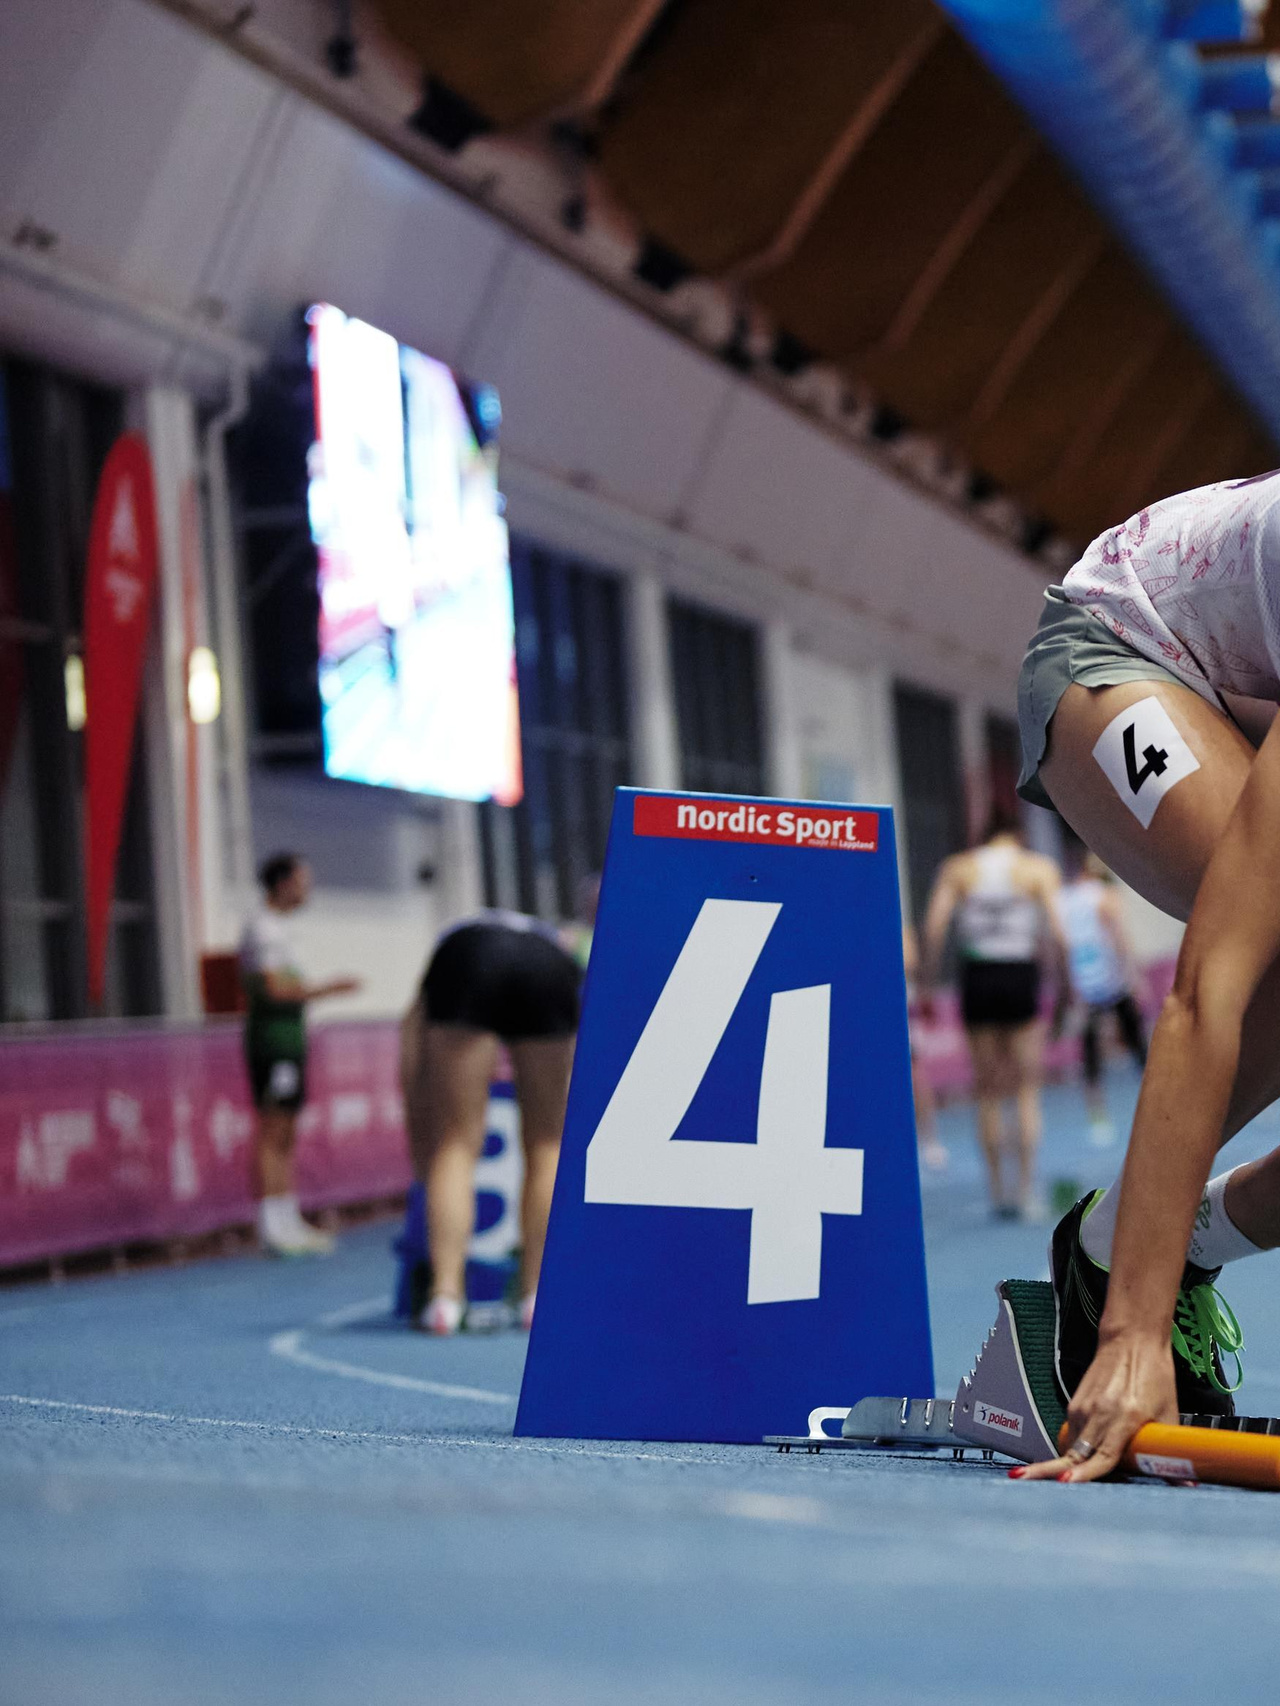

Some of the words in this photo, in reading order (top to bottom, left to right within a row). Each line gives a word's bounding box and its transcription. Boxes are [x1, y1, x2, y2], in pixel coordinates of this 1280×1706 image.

[1123, 722, 1169, 795] 4
[776, 812, 857, 844] Sport
[584, 898, 864, 1305] 4
[988, 1412, 1020, 1431] polanik
